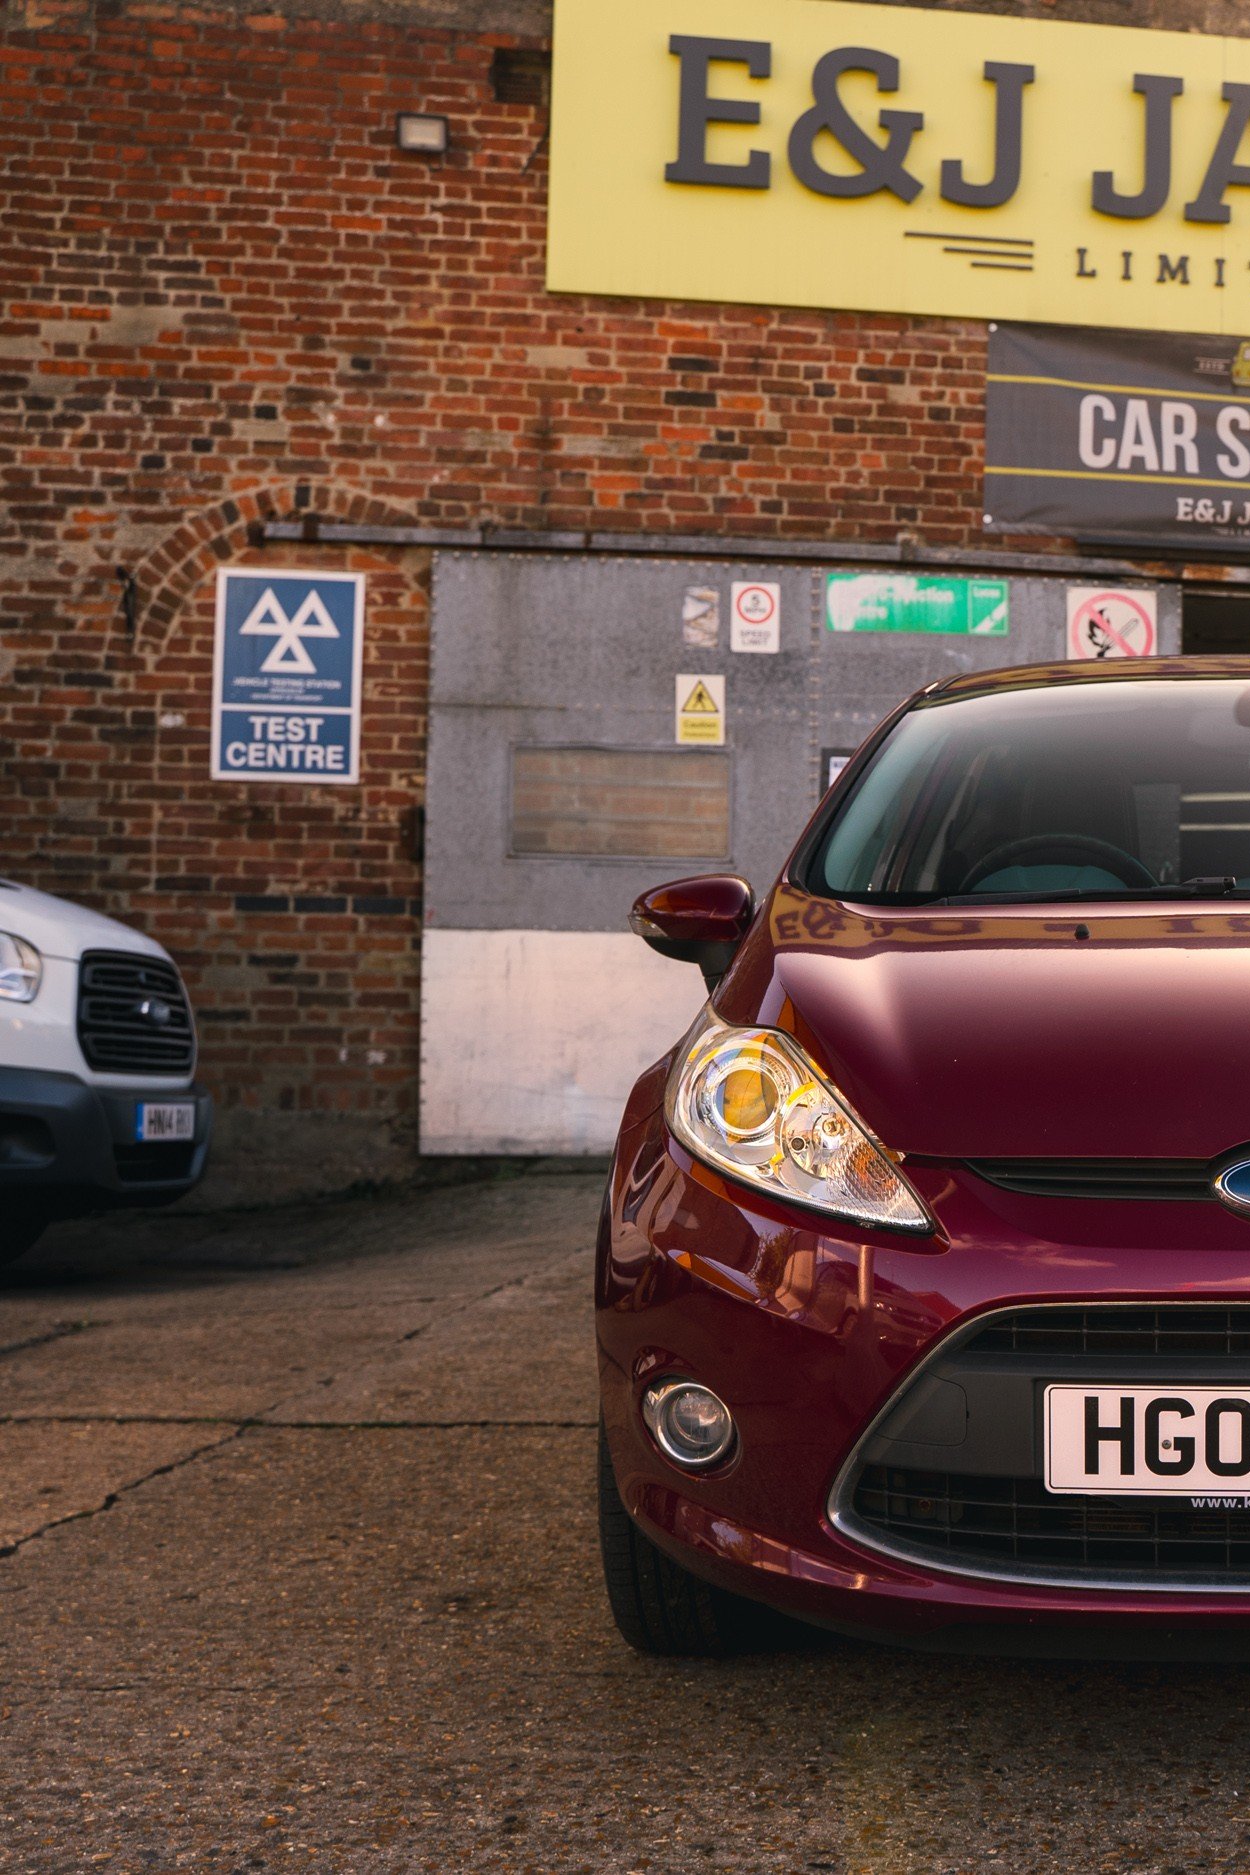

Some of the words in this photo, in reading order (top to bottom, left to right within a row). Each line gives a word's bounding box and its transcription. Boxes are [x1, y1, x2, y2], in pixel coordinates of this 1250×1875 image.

[665, 34, 1036, 208] E&J
[1077, 394, 1200, 475] CAR
[1175, 497, 1233, 524] E&J
[248, 715, 325, 743] TEST
[225, 741, 346, 770] CENTRE
